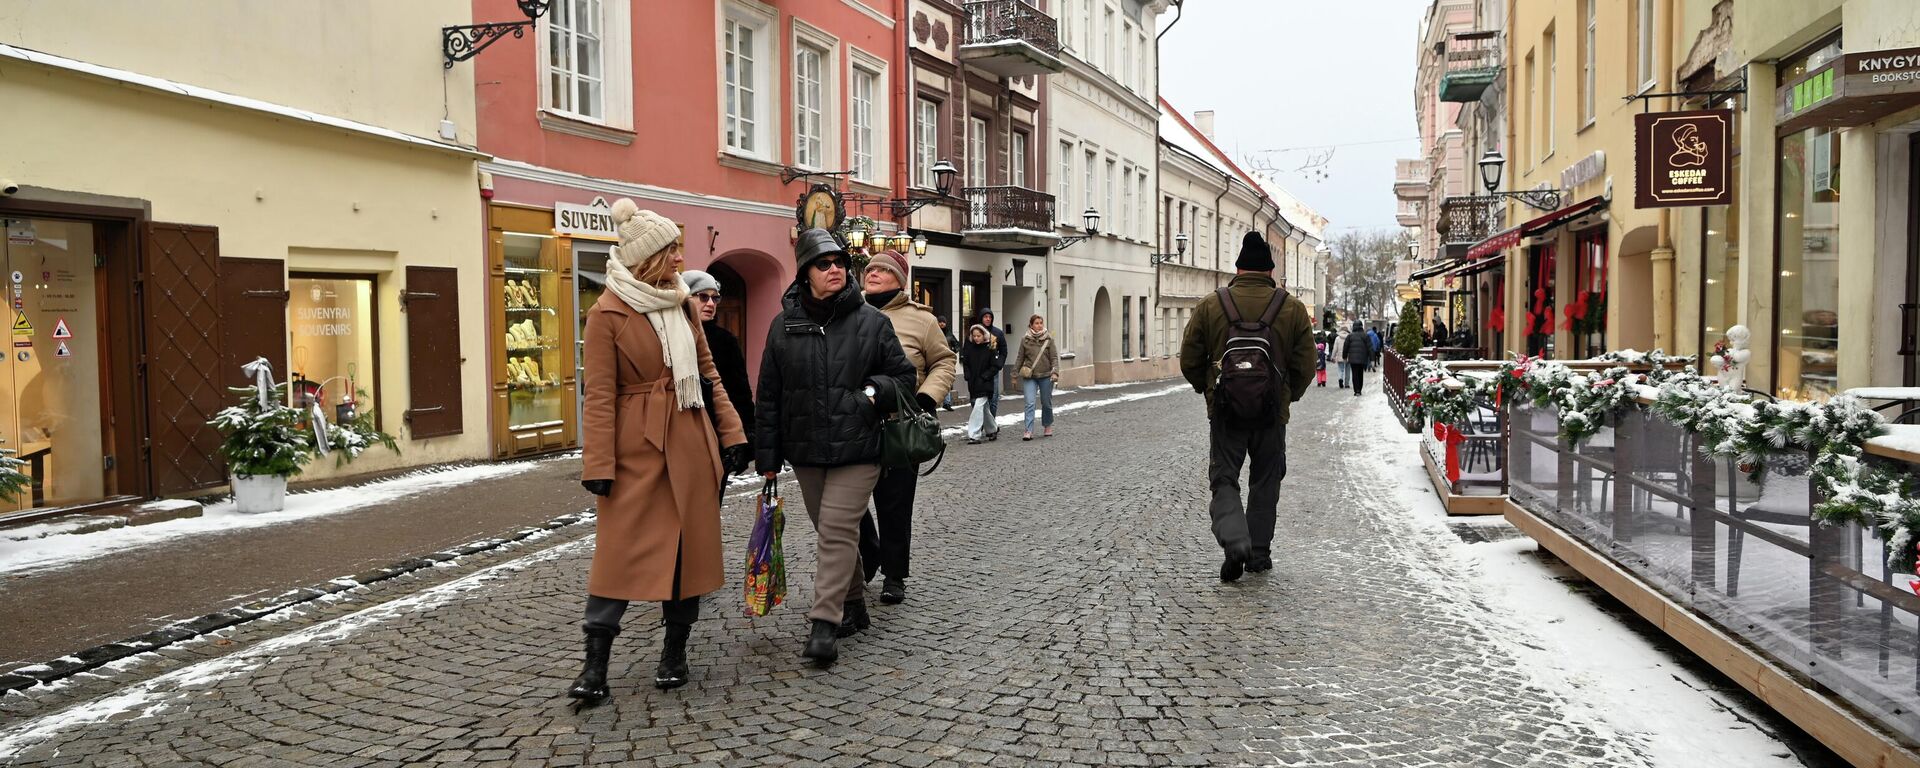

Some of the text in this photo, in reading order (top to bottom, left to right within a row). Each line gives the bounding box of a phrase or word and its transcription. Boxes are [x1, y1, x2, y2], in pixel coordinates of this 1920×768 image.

[1669, 168, 1707, 178] ESKEDAR
[1671, 176, 1703, 186] COFFEE
[298, 306, 351, 320] SUVENYRAI
[298, 323, 352, 336] SOUVENIRS
